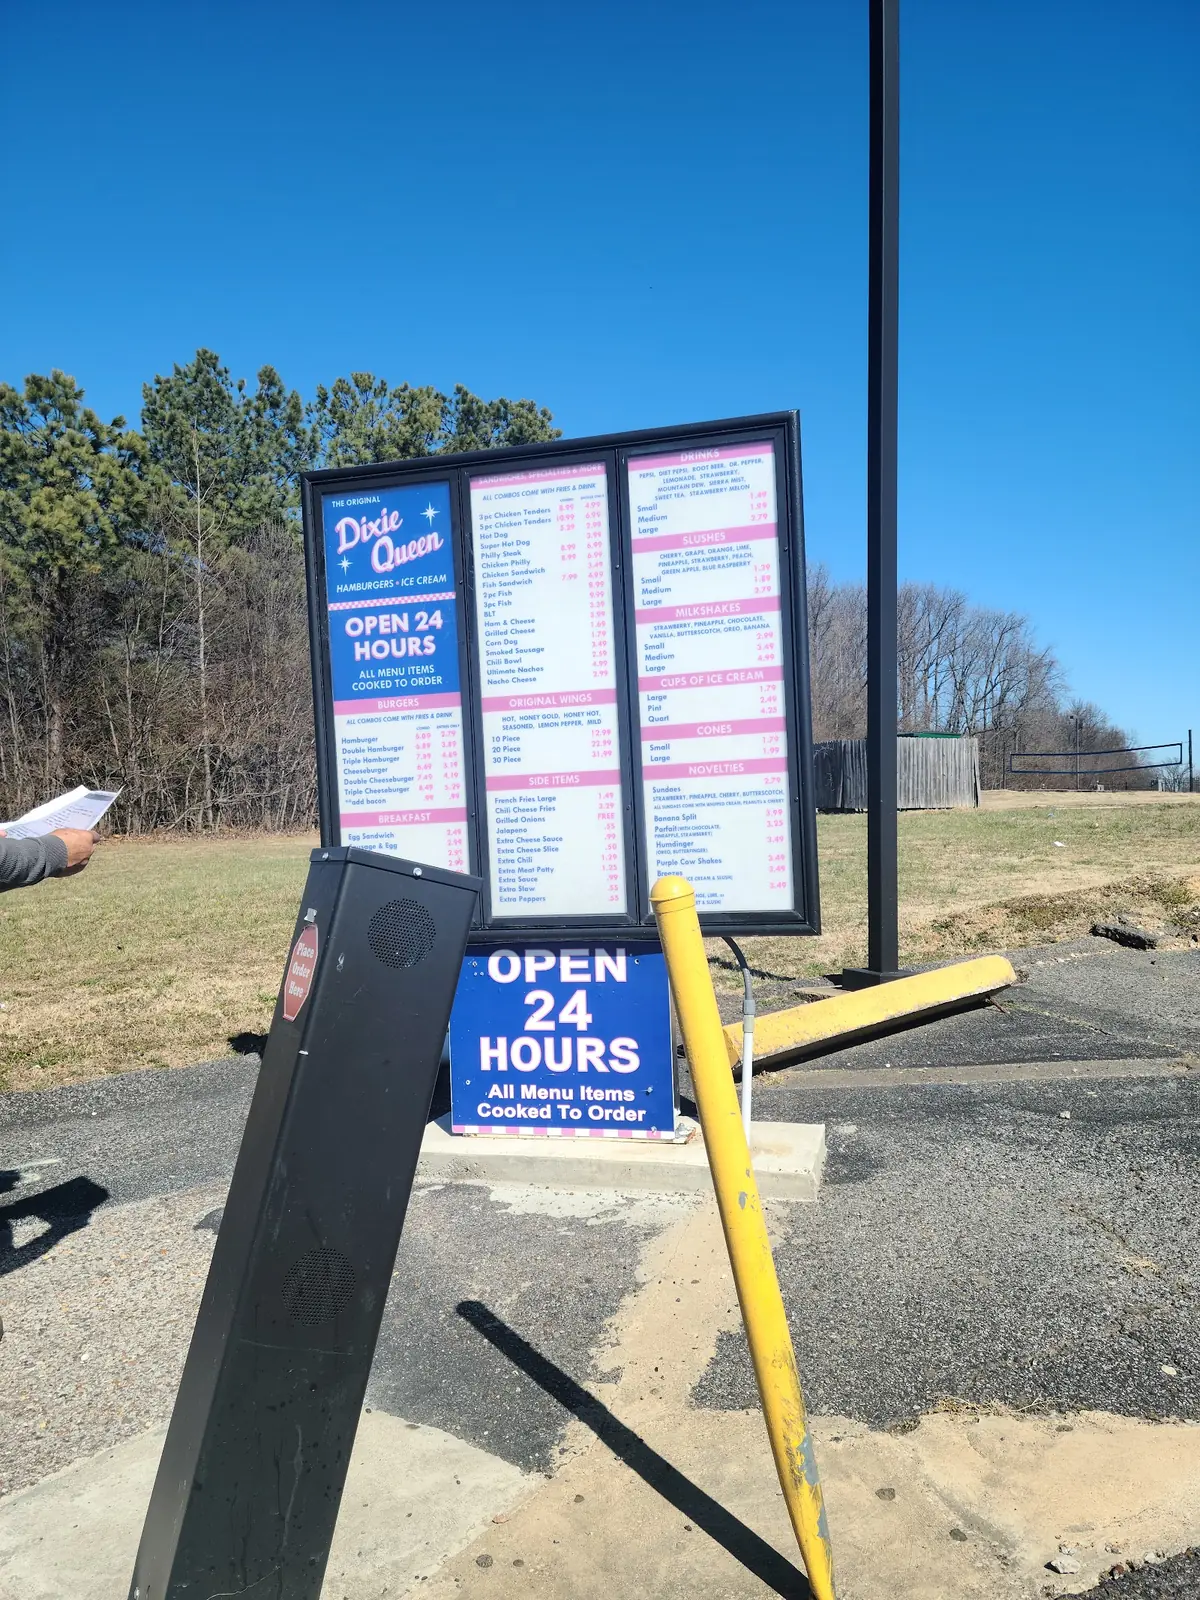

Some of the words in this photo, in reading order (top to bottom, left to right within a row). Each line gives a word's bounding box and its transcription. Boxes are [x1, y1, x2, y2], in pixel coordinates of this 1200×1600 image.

[680, 448, 720, 462] DRINKS
[346, 496, 380, 506] ORIGINAL
[637, 504, 658, 512] Small
[638, 514, 668, 524] Medium
[335, 508, 403, 554] Dixie
[638, 526, 658, 534] Large
[494, 532, 508, 540] Dog
[682, 532, 726, 545] SLUSHES
[371, 532, 444, 573] Queen
[481, 552, 500, 560] Philly
[691, 554, 730, 564] STRAWBERRY,
[718, 560, 750, 569] RASPBERRY
[482, 571, 510, 579] Chicken
[512, 568, 546, 576] Sandwich
[336, 580, 394, 592] HAMBURGERS
[401, 578, 414, 586] ICE
[416, 574, 446, 584] CREAM
[498, 579, 532, 587] Sandwich
[641, 576, 662, 584] Small
[642, 586, 672, 595] Medium
[642, 598, 662, 606] Large
[676, 603, 740, 618] MILKSHAKES
[345, 612, 408, 637] OPEN
[415, 610, 443, 631] 24
[728, 616, 765, 624] CHOCOLATE,
[354, 635, 436, 661] HOURS
[516, 646, 544, 654] Sausage
[644, 653, 674, 661] Medium
[360, 670, 375, 679] ALL
[378, 668, 404, 678] MENU
[408, 665, 434, 675] ITEMS
[352, 680, 392, 690] COOKED
[394, 679, 408, 688] TO
[410, 676, 442, 686] ORDER
[660, 677, 686, 688] CUPS
[690, 676, 704, 686] OF
[707, 674, 722, 684] ICE
[726, 671, 764, 682] CREAM
[378, 698, 419, 709] BURGERS
[509, 696, 557, 708] ORIGINAL
[560, 693, 592, 704] WINGS
[697, 724, 732, 736] CONES
[342, 736, 378, 744] Hamburger
[363, 756, 400, 764] Hamburger
[344, 768, 388, 776] Cheeseburger
[688, 763, 744, 775] NOVELTIES
[369, 776, 414, 784] Cheeseburger
[528, 776, 549, 786] SIDE
[552, 775, 580, 784] ITEMS
[344, 788, 363, 796] Triple
[364, 786, 409, 795] Cheeseburger
[378, 812, 432, 824] BREAKFAST
[682, 814, 697, 822] Split
[348, 833, 360, 841] Egg
[296, 942, 314, 958] Place
[292, 962, 310, 978] Order
[488, 948, 627, 984] OPEN
[288, 981, 304, 998] Here
[524, 990, 592, 1031] 24
[480, 1036, 640, 1073] HOURS
[488, 1084, 514, 1099] All
[521, 1084, 574, 1100] Menu
[580, 1086, 634, 1101] Items
[477, 1102, 551, 1119] Cooked
[558, 1105, 582, 1120] To
[588, 1106, 646, 1122] Order
